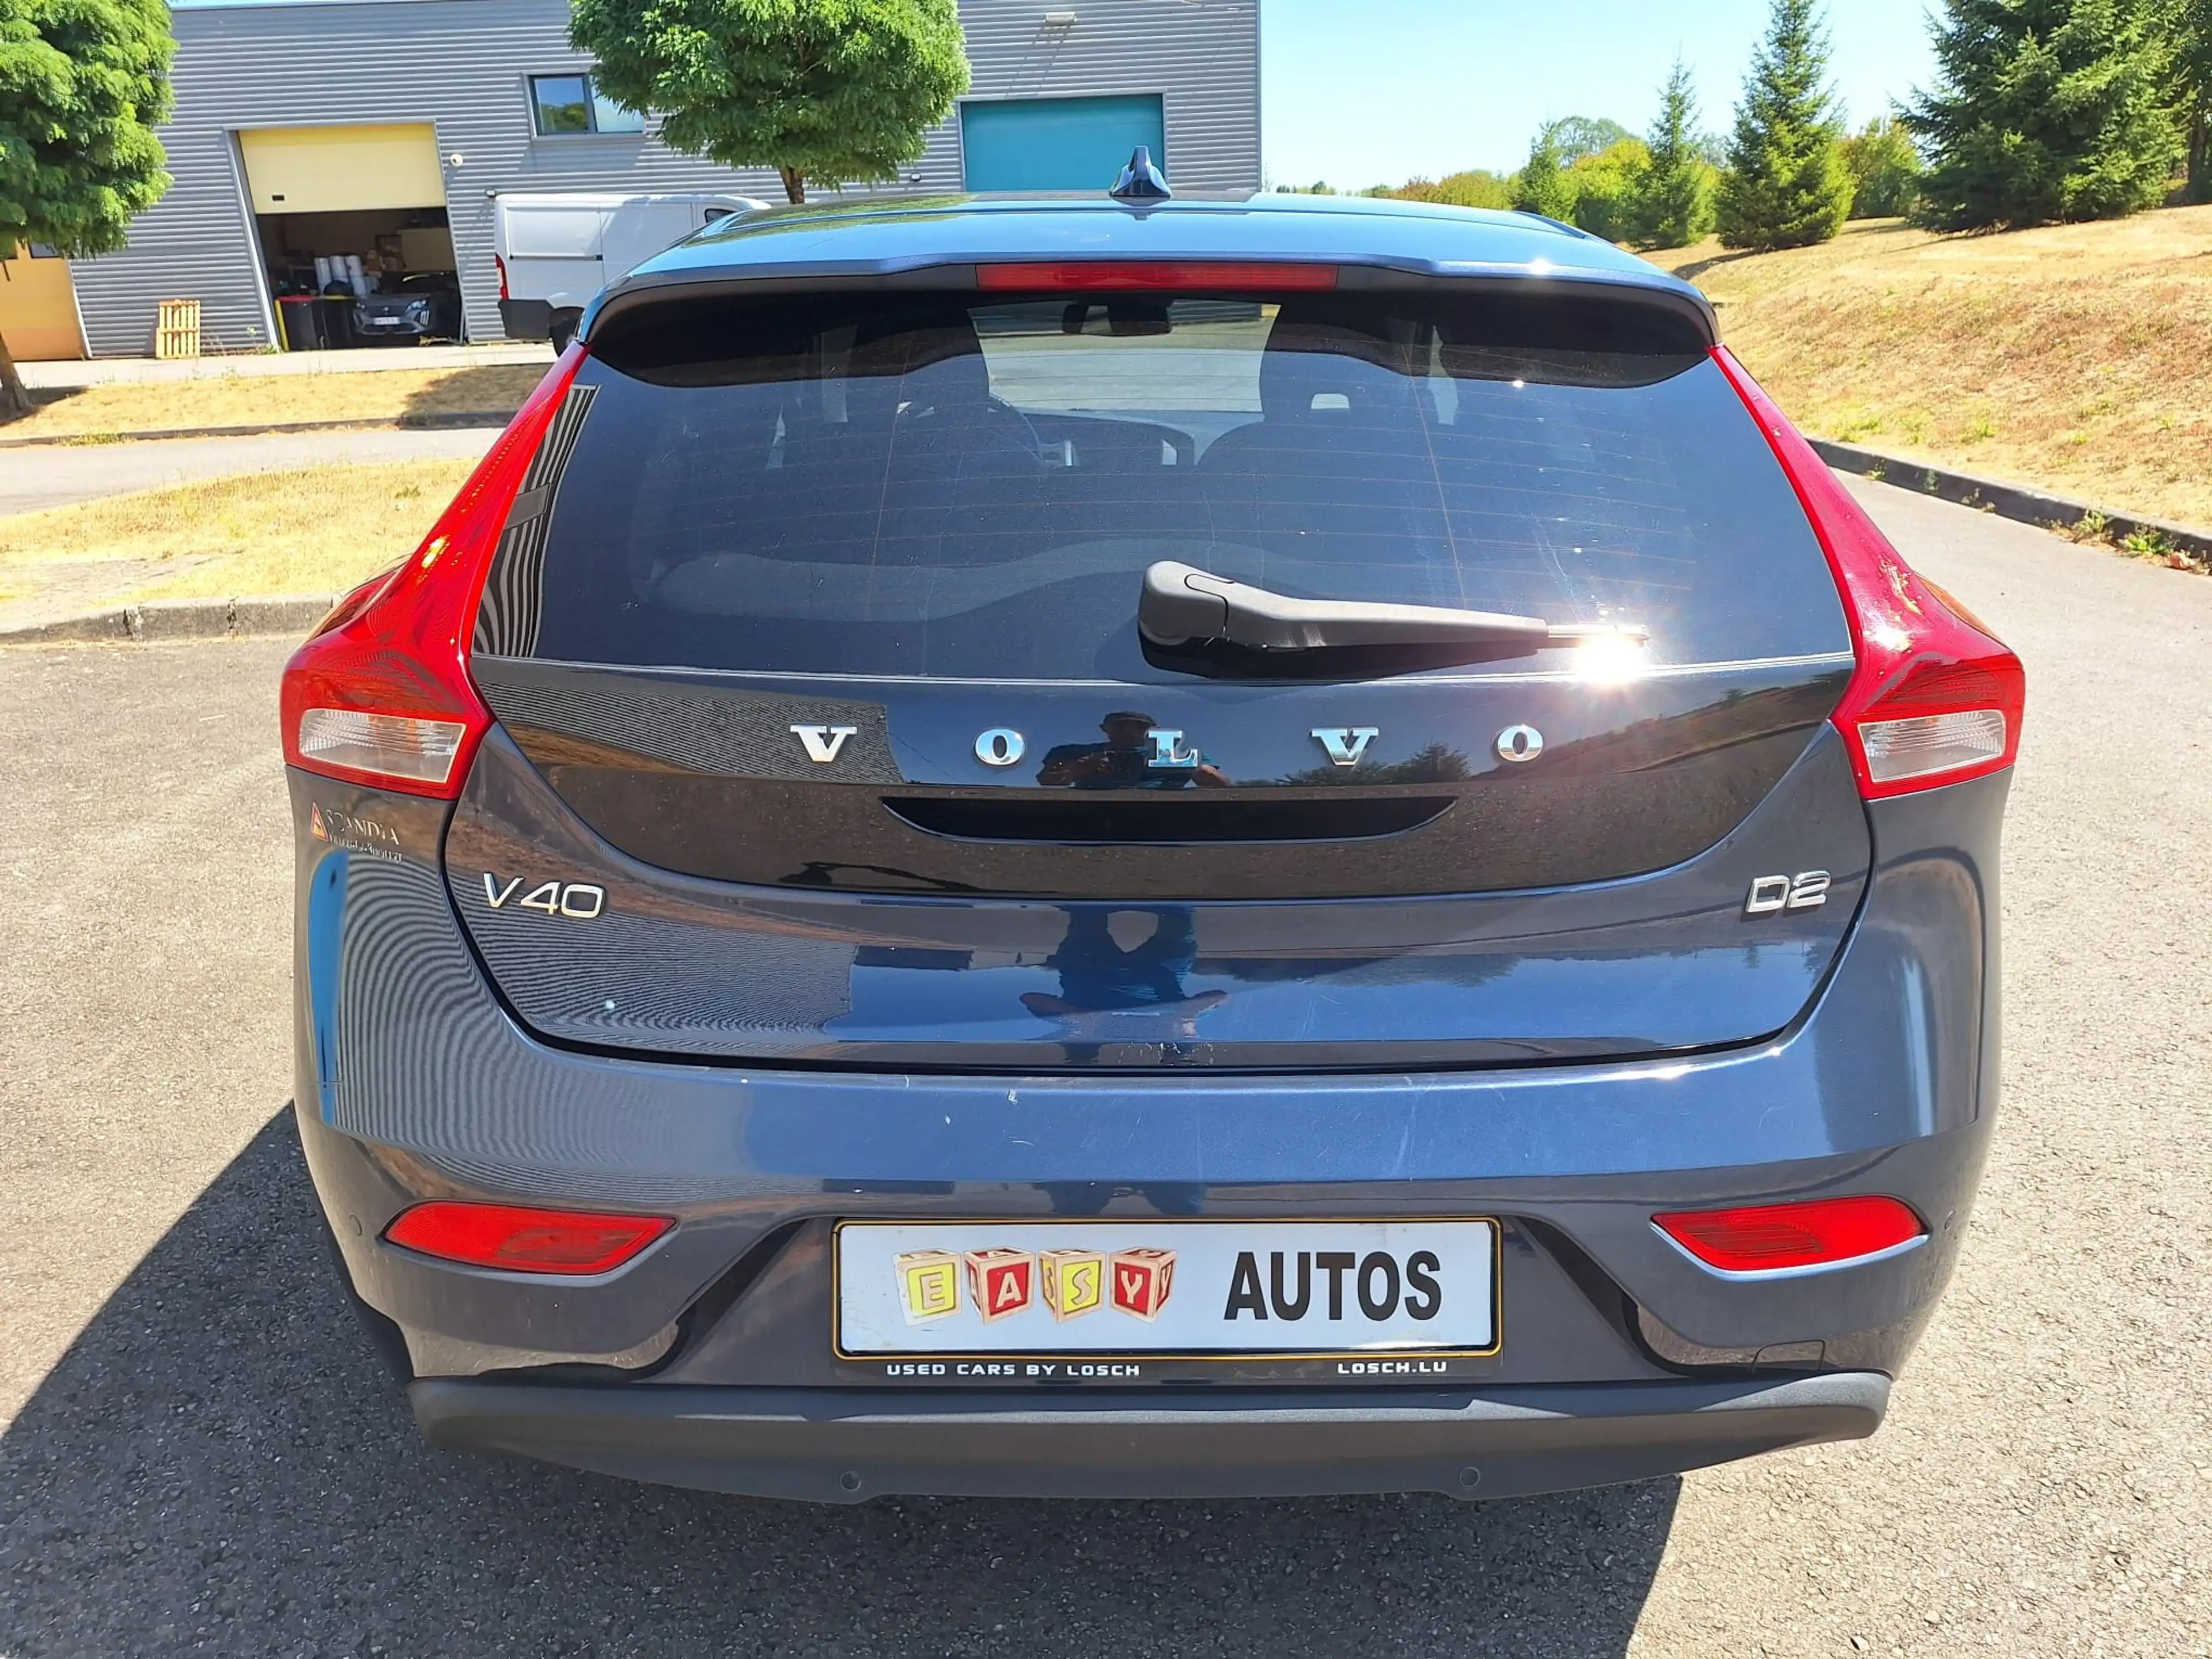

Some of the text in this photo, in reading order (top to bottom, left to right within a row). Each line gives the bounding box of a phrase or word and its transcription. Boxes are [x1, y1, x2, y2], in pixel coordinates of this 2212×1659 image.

[789, 724, 1544, 767] VOLVO
[483, 872, 605, 919] V40
[1745, 870, 1831, 913] D2
[921, 1251, 1442, 1321] EASY AUTOS
[886, 1363, 1140, 1377] USED CARS BY LOSCH
[1337, 1361, 1448, 1374] LOSCH.LU
